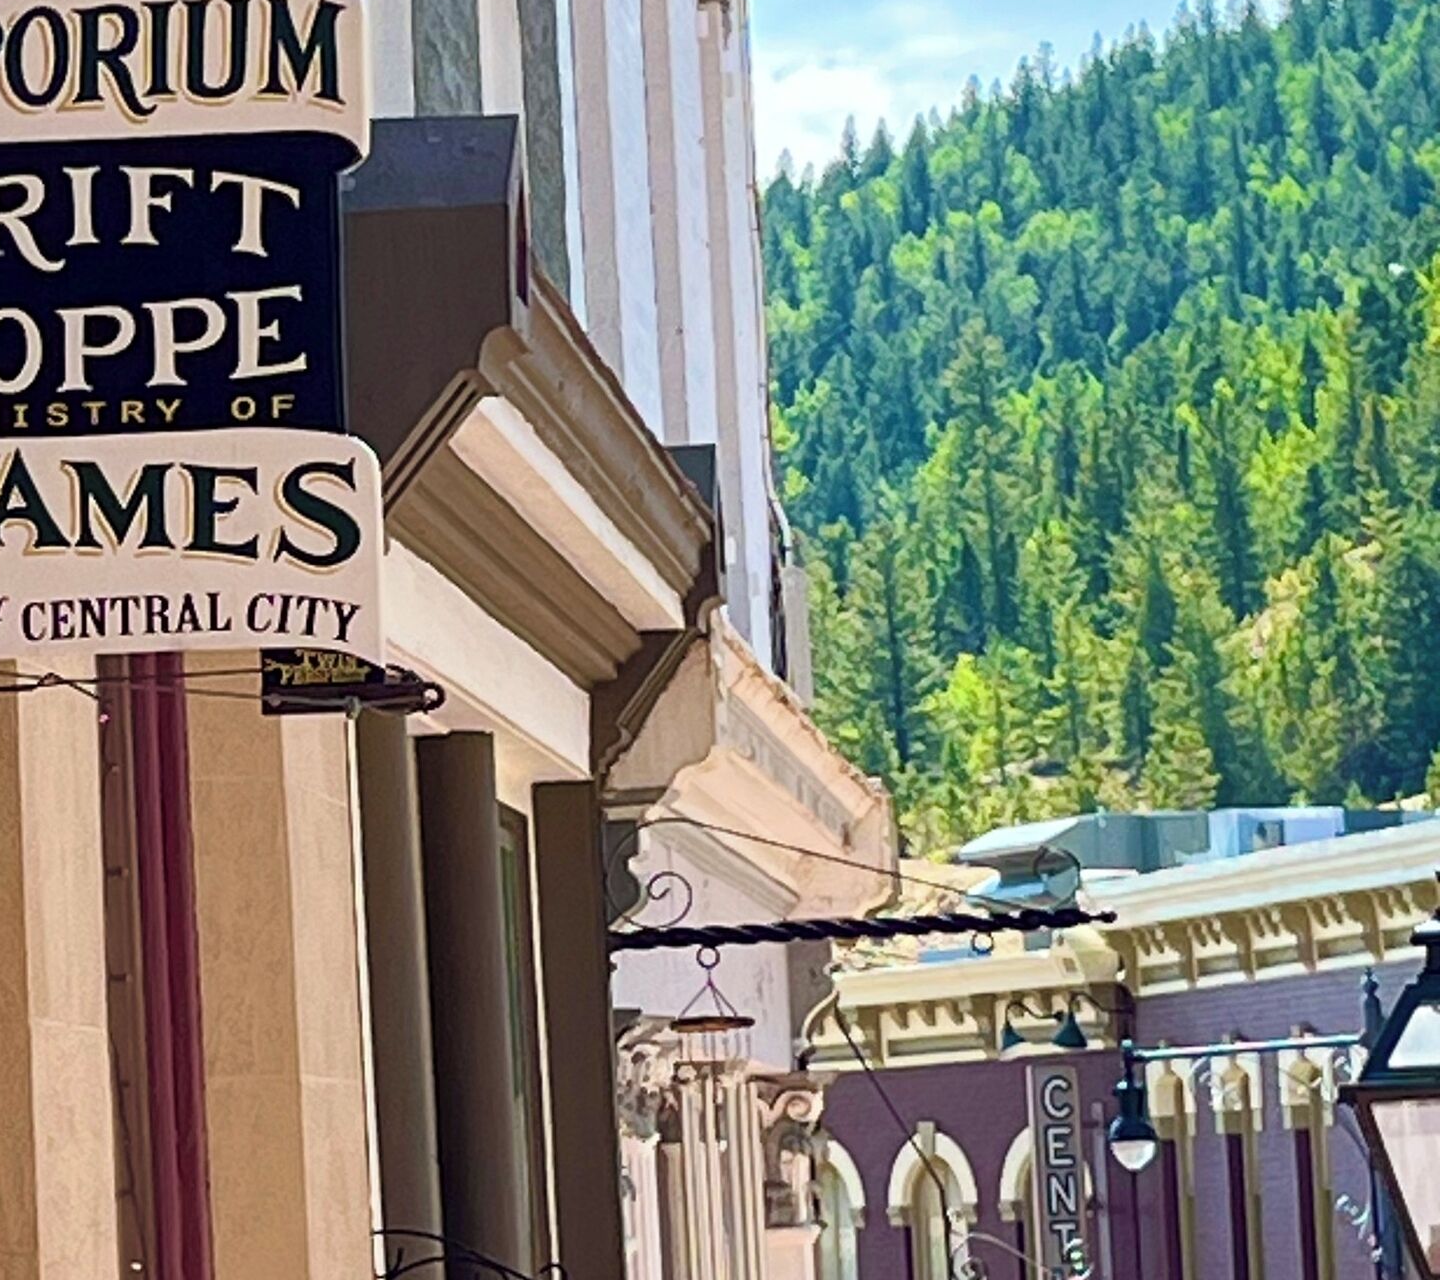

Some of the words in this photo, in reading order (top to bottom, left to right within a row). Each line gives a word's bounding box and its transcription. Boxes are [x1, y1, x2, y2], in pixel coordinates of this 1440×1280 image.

[230, 394, 295, 421] OF
[22, 591, 233, 642] CENTRAL
[246, 592, 362, 644] CITY
